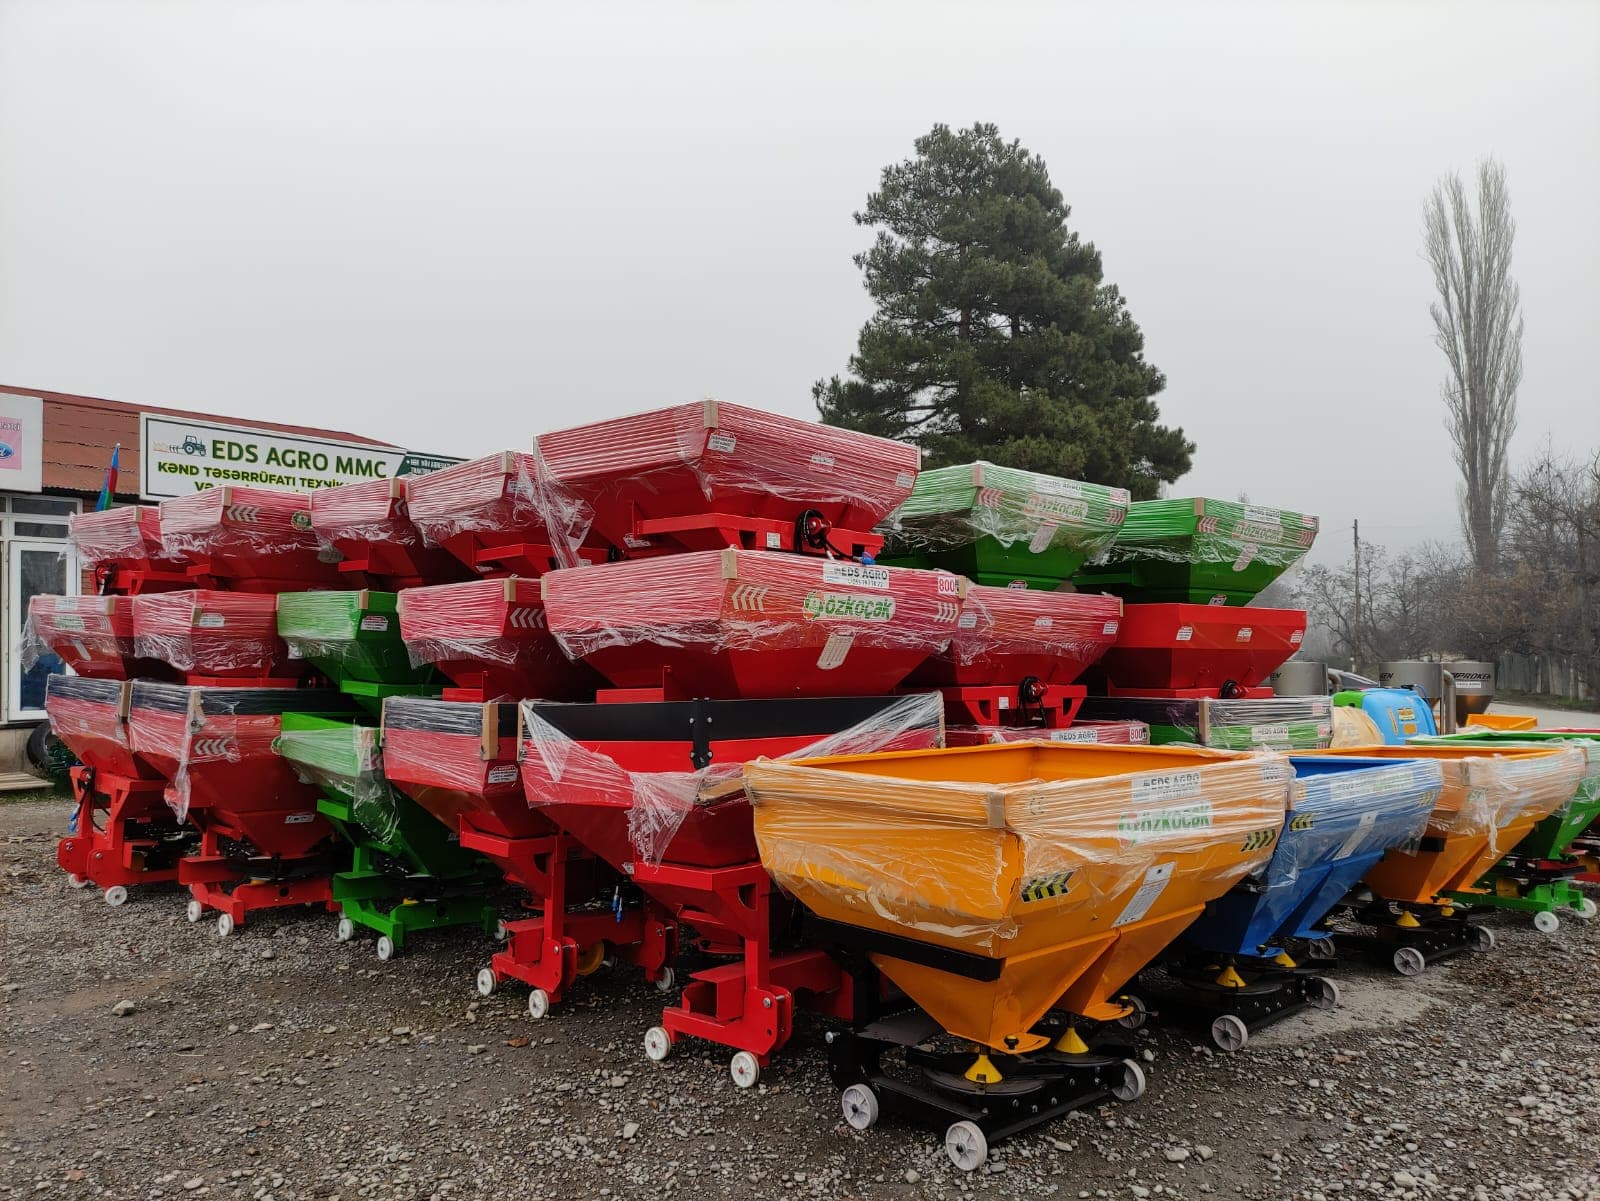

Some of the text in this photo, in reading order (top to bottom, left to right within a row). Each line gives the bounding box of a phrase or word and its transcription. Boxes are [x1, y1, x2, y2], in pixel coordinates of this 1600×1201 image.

[211, 439, 387, 478] EDS AGRO MMC
[157, 461, 200, 476] KƏND
[203, 466, 296, 486] TƏSƏRRÜFATI
[194, 481, 214, 491] VƏ
[841, 566, 888, 580] EDS AGRO
[939, 578, 955, 592] 800
